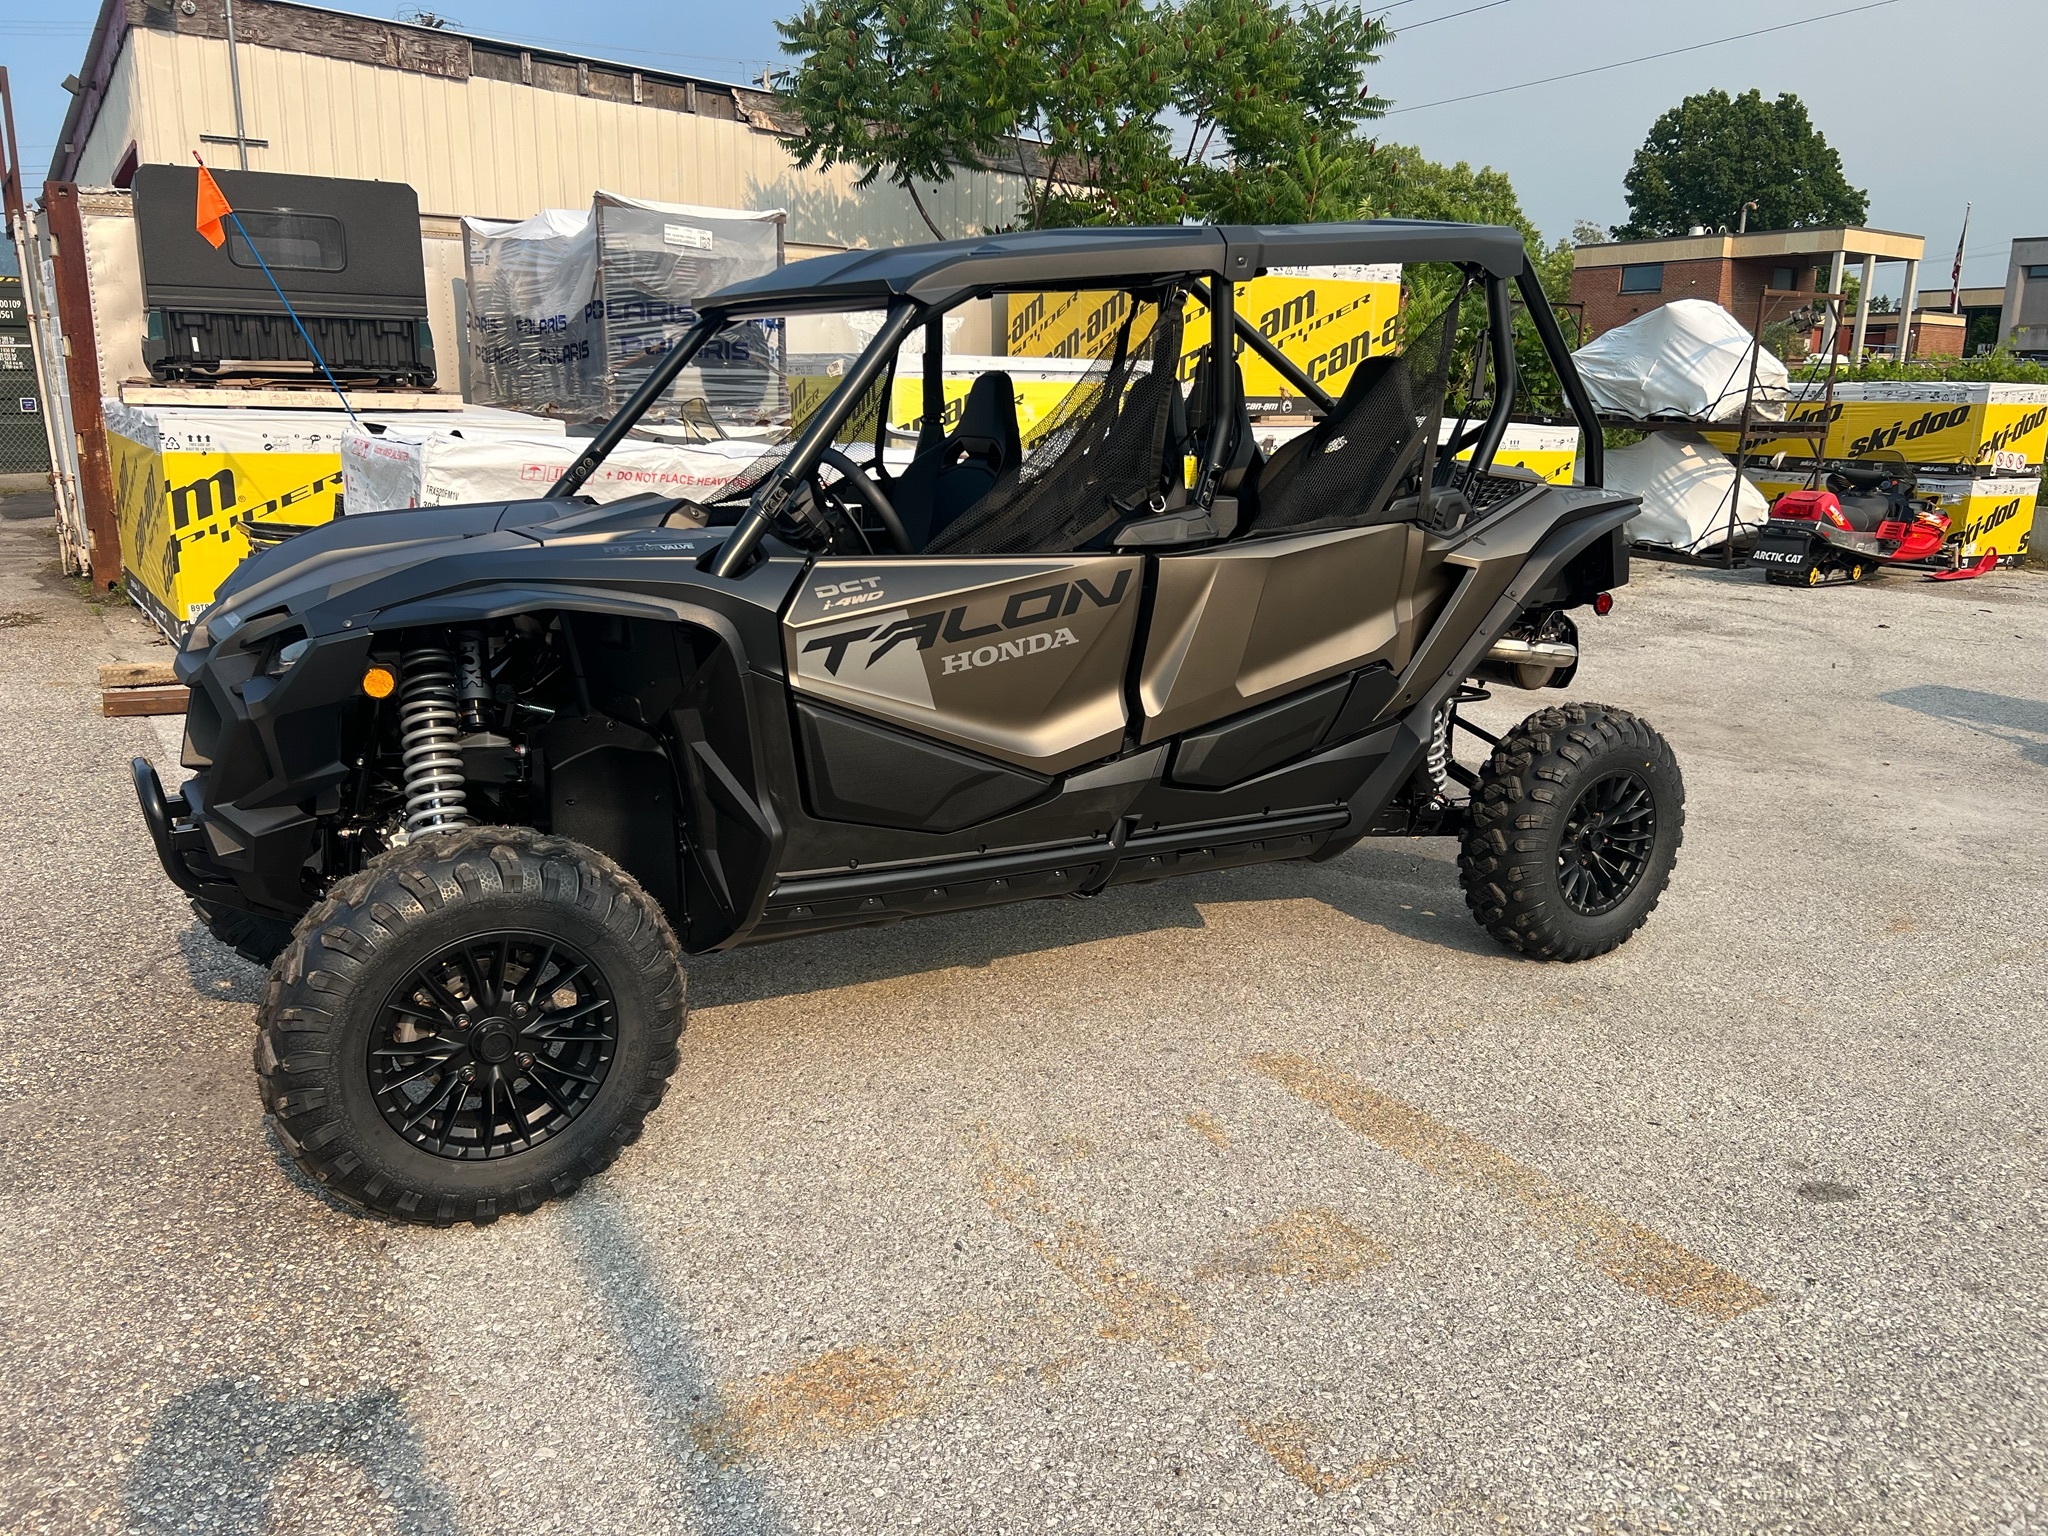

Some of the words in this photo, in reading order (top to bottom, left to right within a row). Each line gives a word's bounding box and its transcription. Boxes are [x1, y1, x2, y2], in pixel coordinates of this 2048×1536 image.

[620, 335, 751, 361] POLRIS
[1306, 314, 1399, 384] can-a
[1847, 405, 1971, 458] ski-doo
[1975, 406, 2048, 463] ski-doo
[617, 471, 633, 480] DO
[635, 472, 658, 483] NOT
[660, 473, 694, 486] PLACE
[697, 477, 730, 486] HEAVY
[1946, 497, 2020, 550] ski-doo
[1752, 550, 1785, 562] ARCTIC
[1785, 553, 1804, 564] CAT
[814, 576, 881, 599] DCT
[823, 590, 885, 611] i-4WD
[802, 570, 1133, 677] TALON
[941, 627, 1079, 676] HONDA
